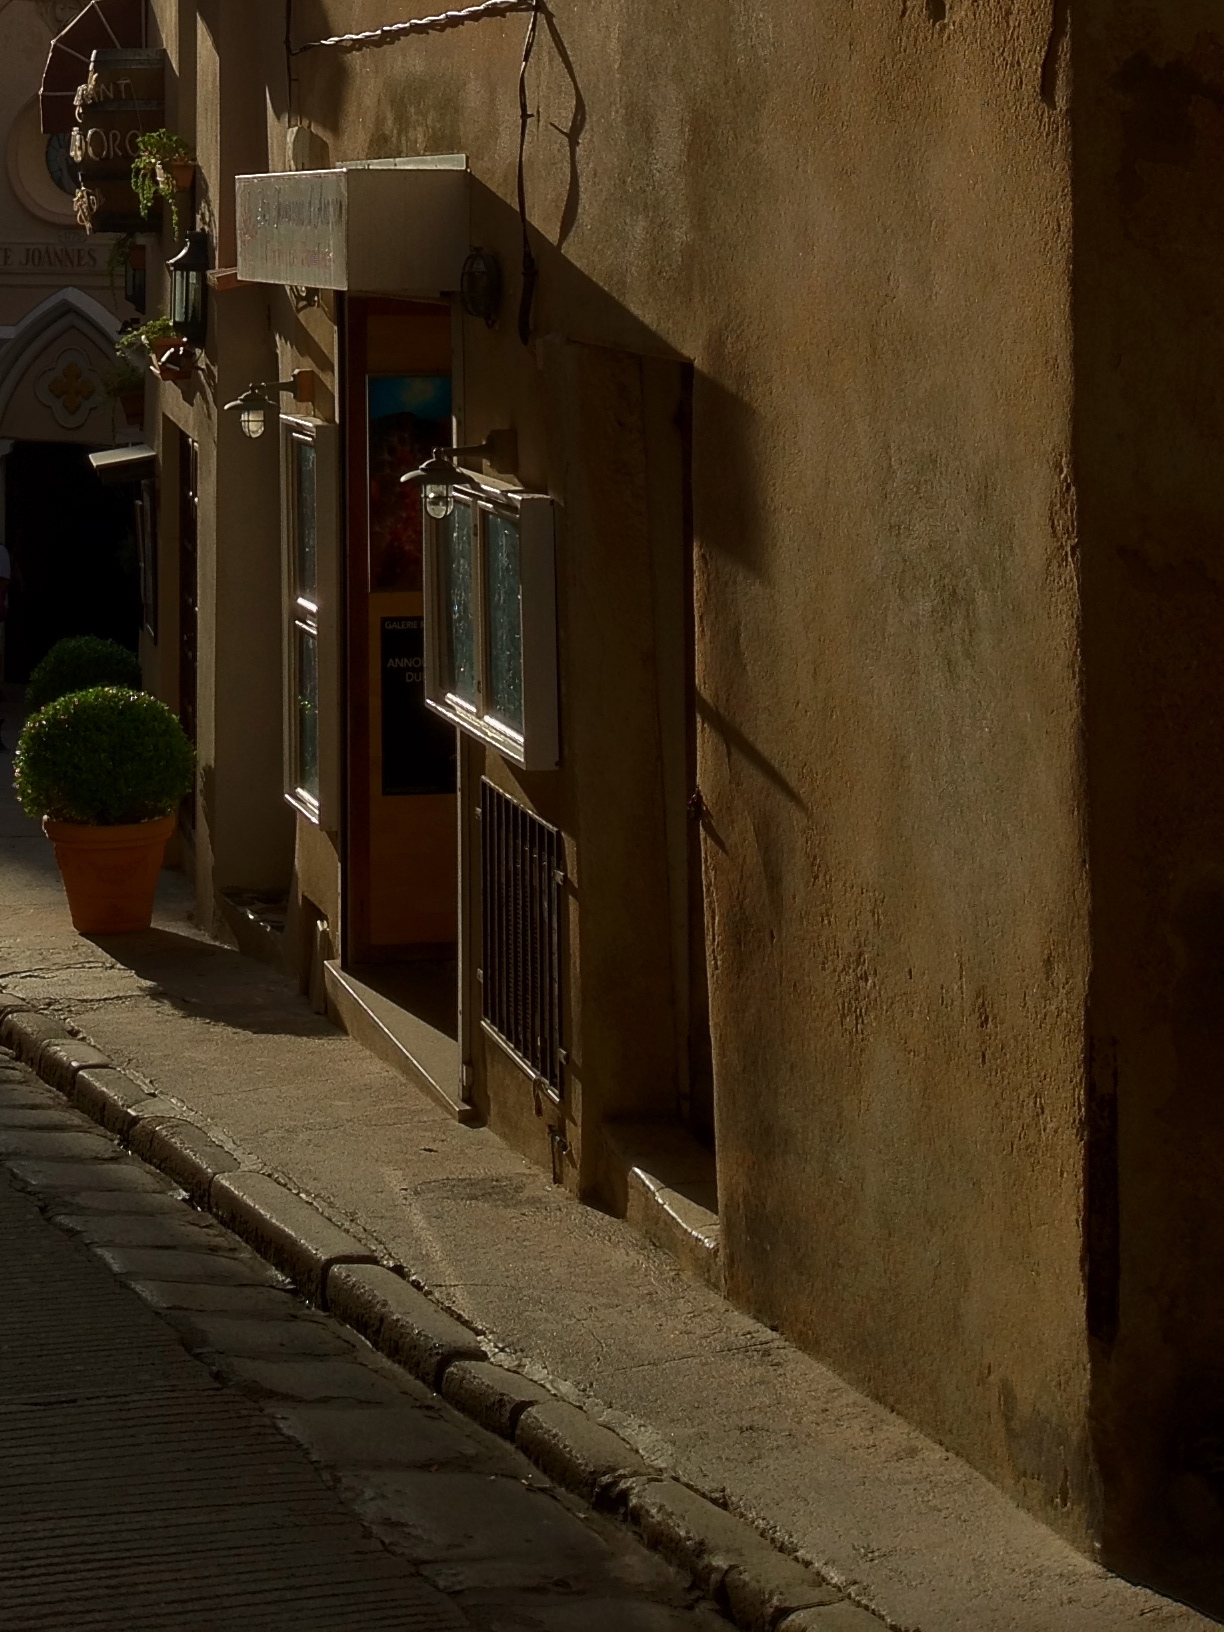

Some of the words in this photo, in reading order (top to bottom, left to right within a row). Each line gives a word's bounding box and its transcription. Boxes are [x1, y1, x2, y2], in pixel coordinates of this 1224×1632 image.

[19, 245, 98, 268] JOANNES
[384, 620, 419, 630] GALERIE
[387, 656, 424, 668] ANNO
